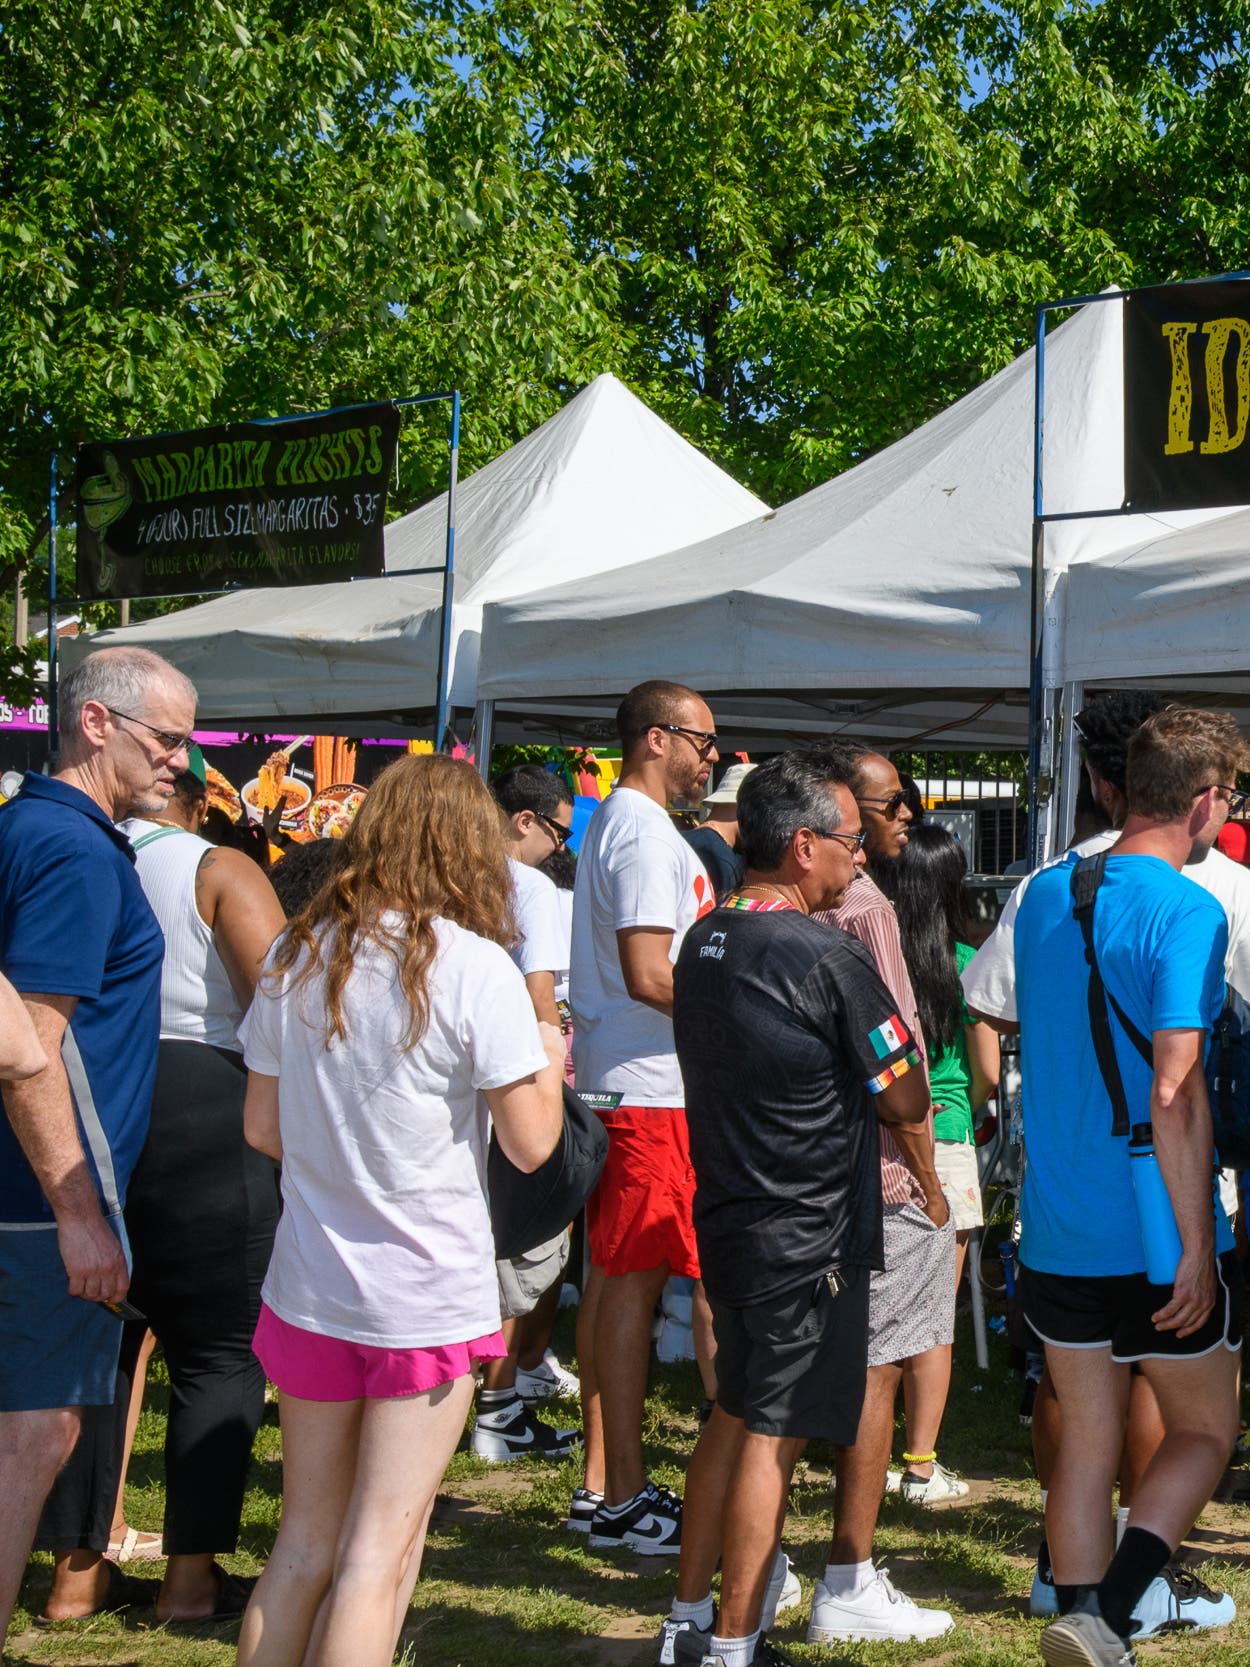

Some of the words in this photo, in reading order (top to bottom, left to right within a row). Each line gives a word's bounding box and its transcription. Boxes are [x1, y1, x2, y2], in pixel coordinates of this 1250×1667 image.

[131, 440, 272, 503] MARGARITA
[276, 425, 383, 487] FLIGHTS
[192, 504, 220, 539] FULL
[256, 495, 340, 535] MARGARITAS
[353, 492, 381, 526] $35
